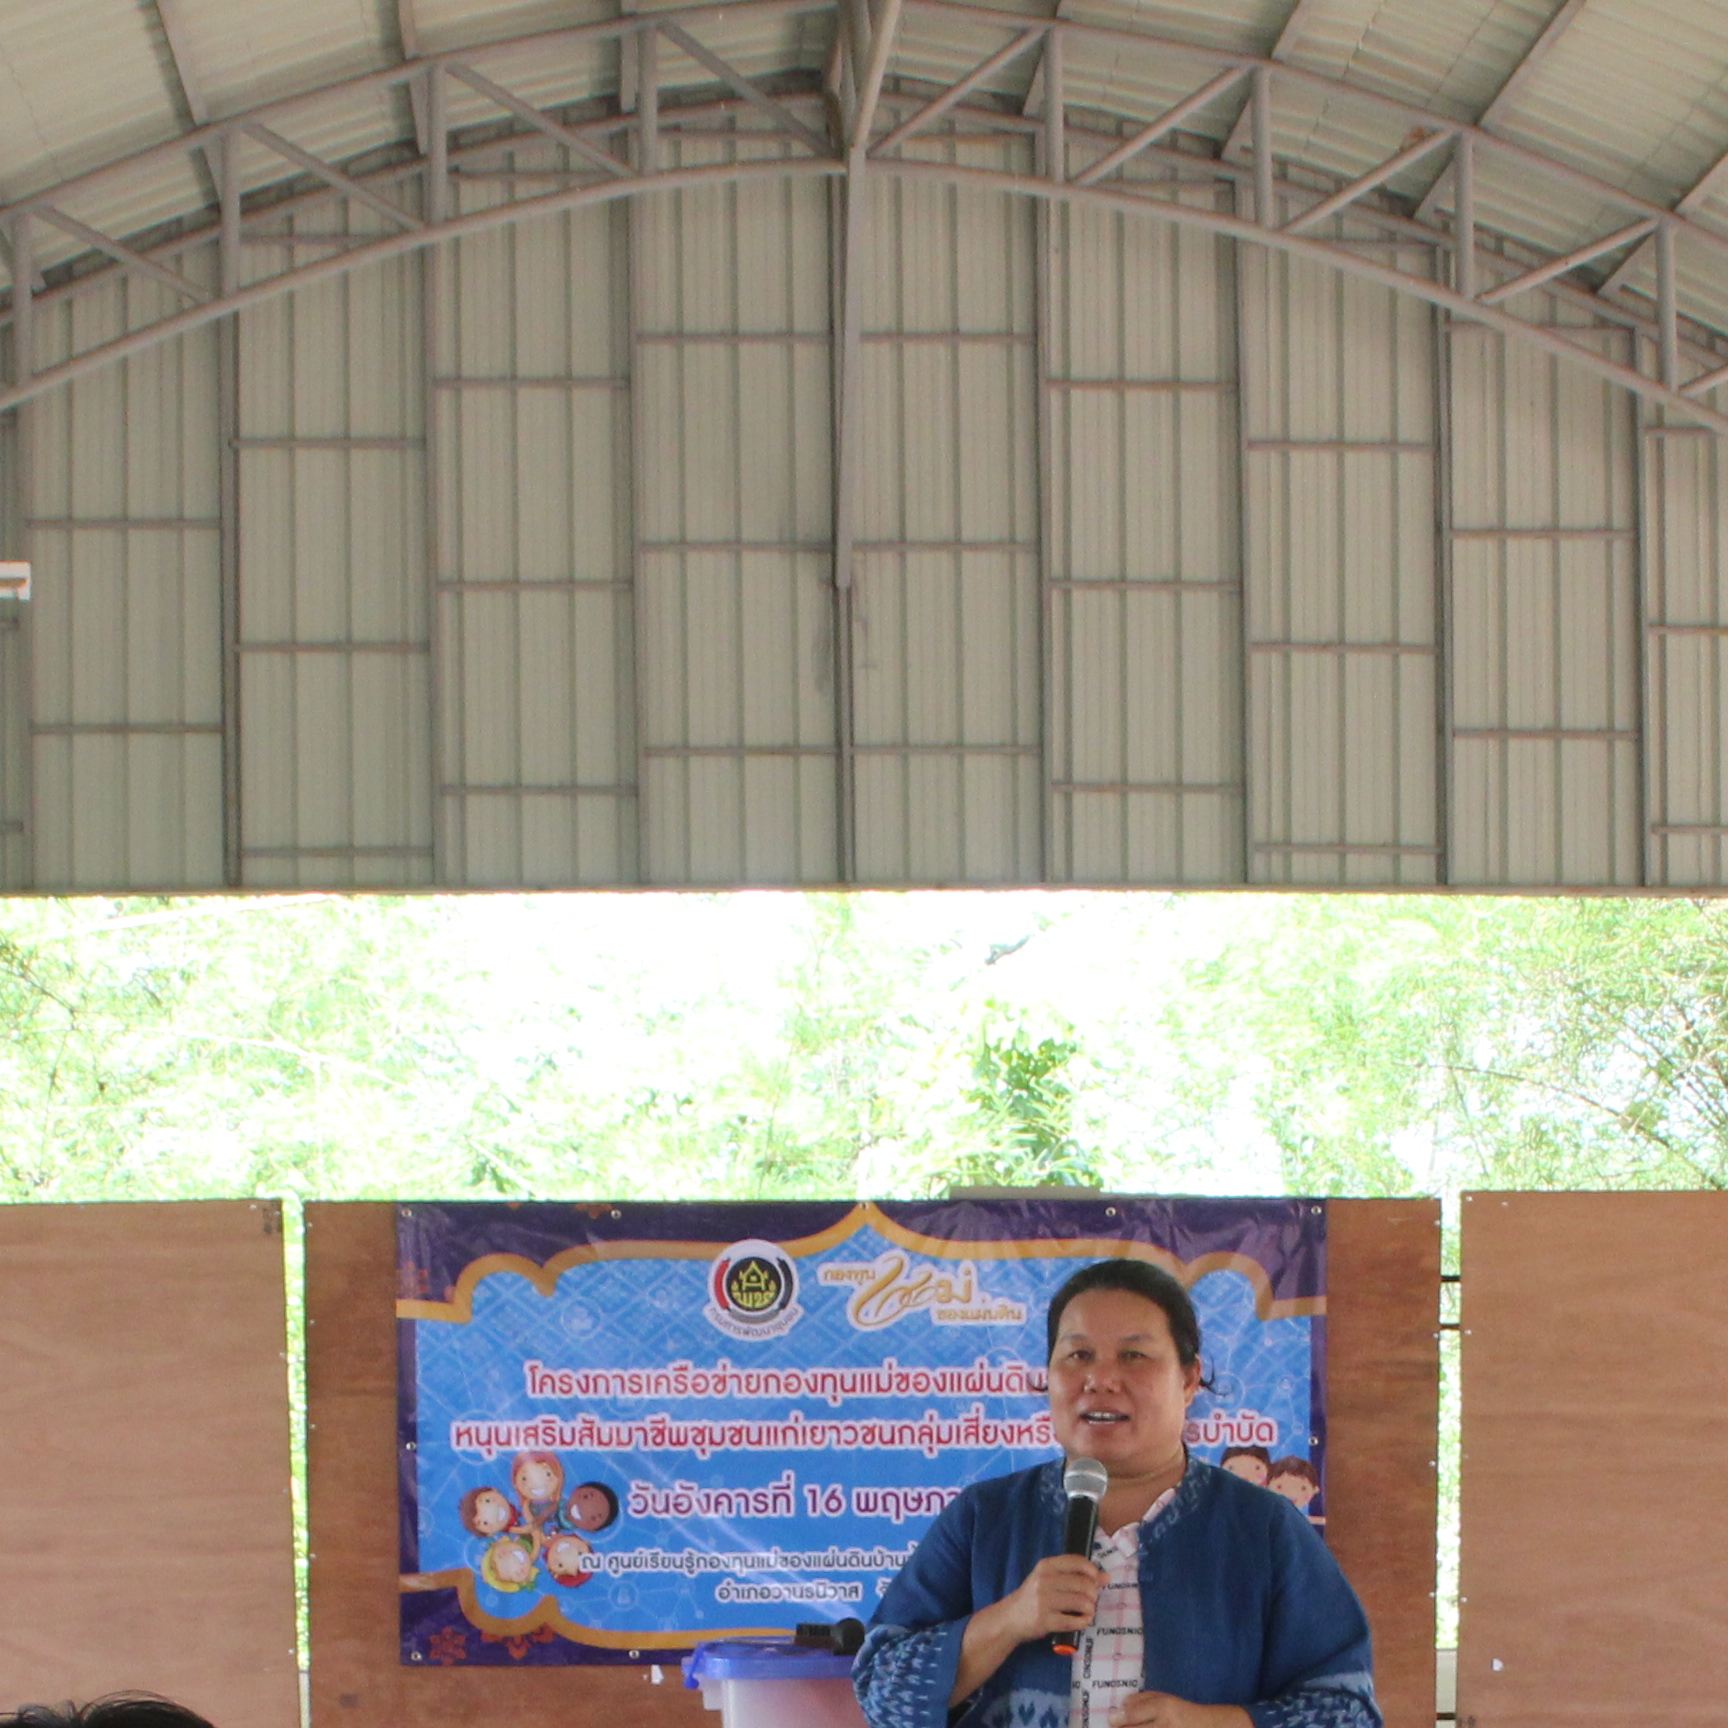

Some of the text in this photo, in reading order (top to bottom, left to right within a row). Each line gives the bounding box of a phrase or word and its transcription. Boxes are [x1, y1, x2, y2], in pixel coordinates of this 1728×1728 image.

[632, 1473, 794, 1515] วันอังคารที่
[807, 1488, 842, 1515] 16
[582, 1555, 601, 1570] ณ
